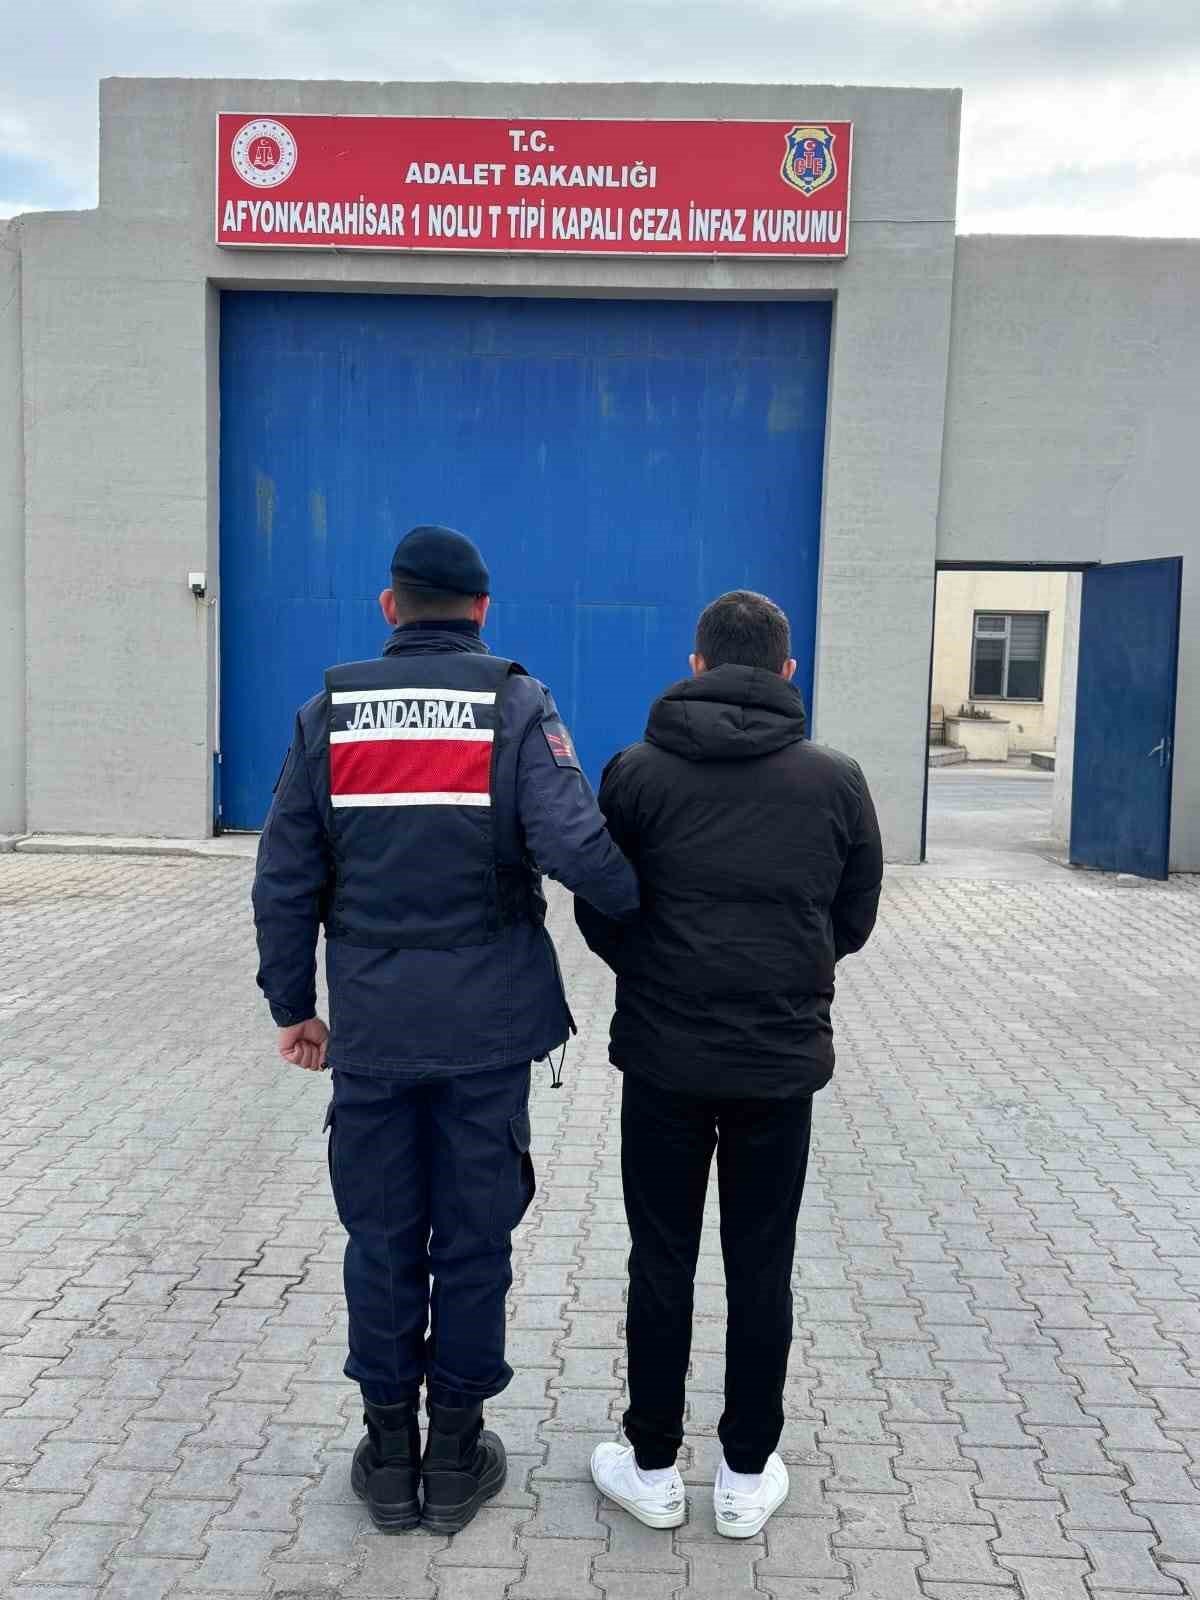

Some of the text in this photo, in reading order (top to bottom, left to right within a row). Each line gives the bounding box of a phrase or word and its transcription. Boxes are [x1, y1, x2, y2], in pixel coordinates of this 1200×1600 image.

[509, 130, 554, 151] T.C.
[405, 161, 657, 188] ADALET BAKANLIĞI
[222, 195, 842, 243] AFYONKARAHİSAR 1 NOLU T TİPİ KAPALI CEZA İNFAZ KURUMU
[347, 700, 476, 730] JANDARMA
